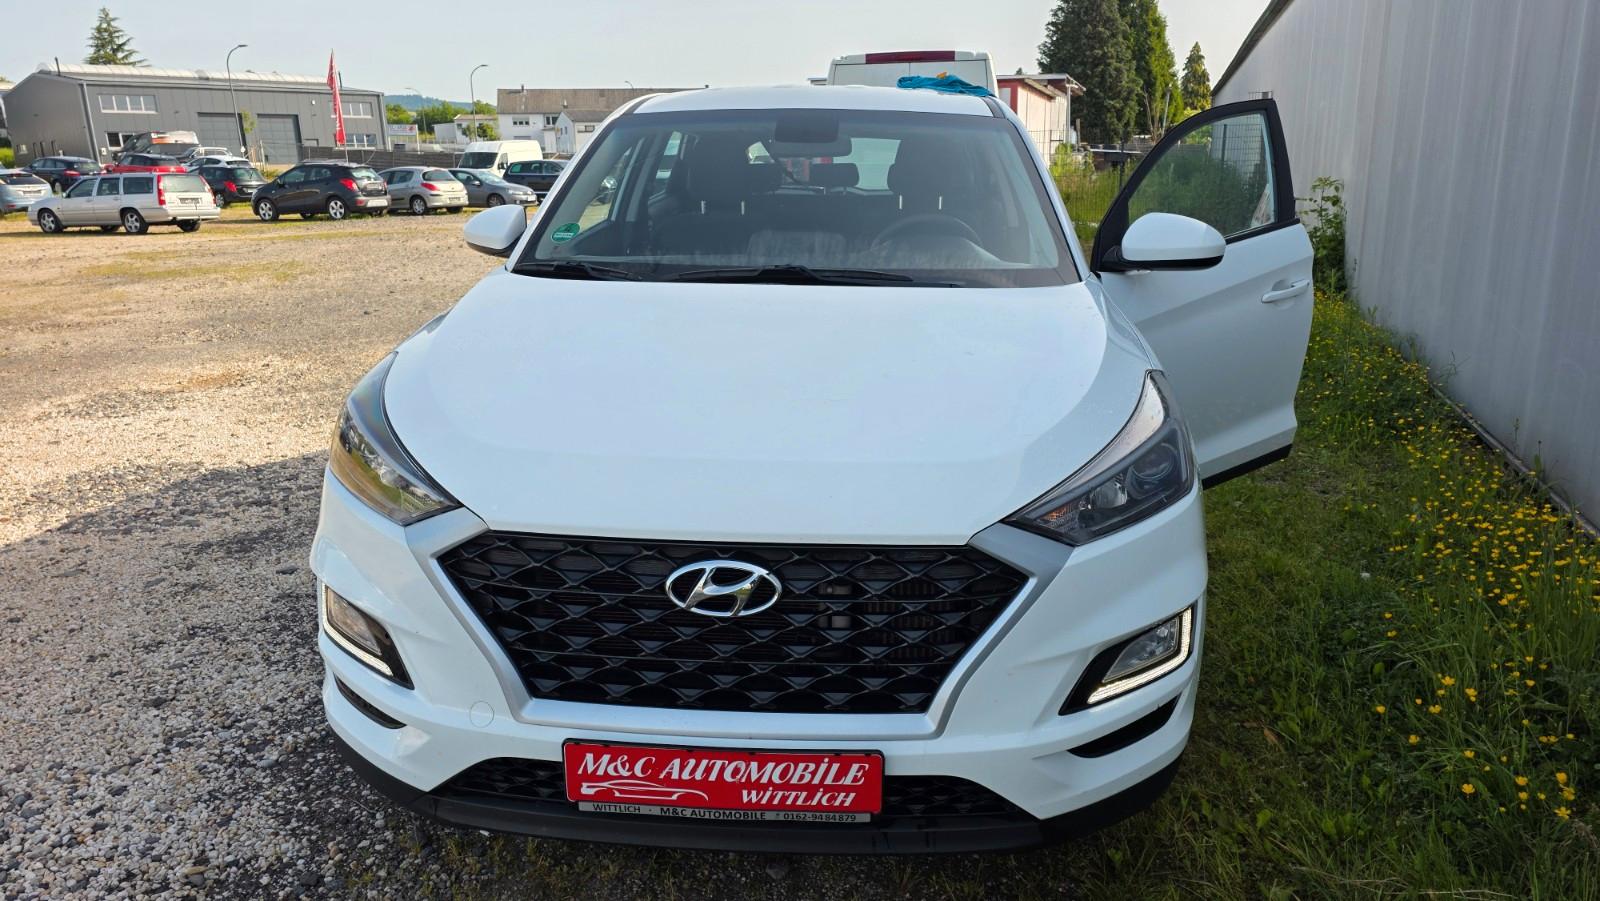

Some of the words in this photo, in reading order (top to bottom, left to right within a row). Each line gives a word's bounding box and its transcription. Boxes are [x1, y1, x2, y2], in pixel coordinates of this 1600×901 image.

[577, 752, 656, 778] M&C
[592, 803, 641, 813] WITTLICH
[659, 807, 688, 817] M&C
[690, 809, 766, 820] AUTOMOBILE
